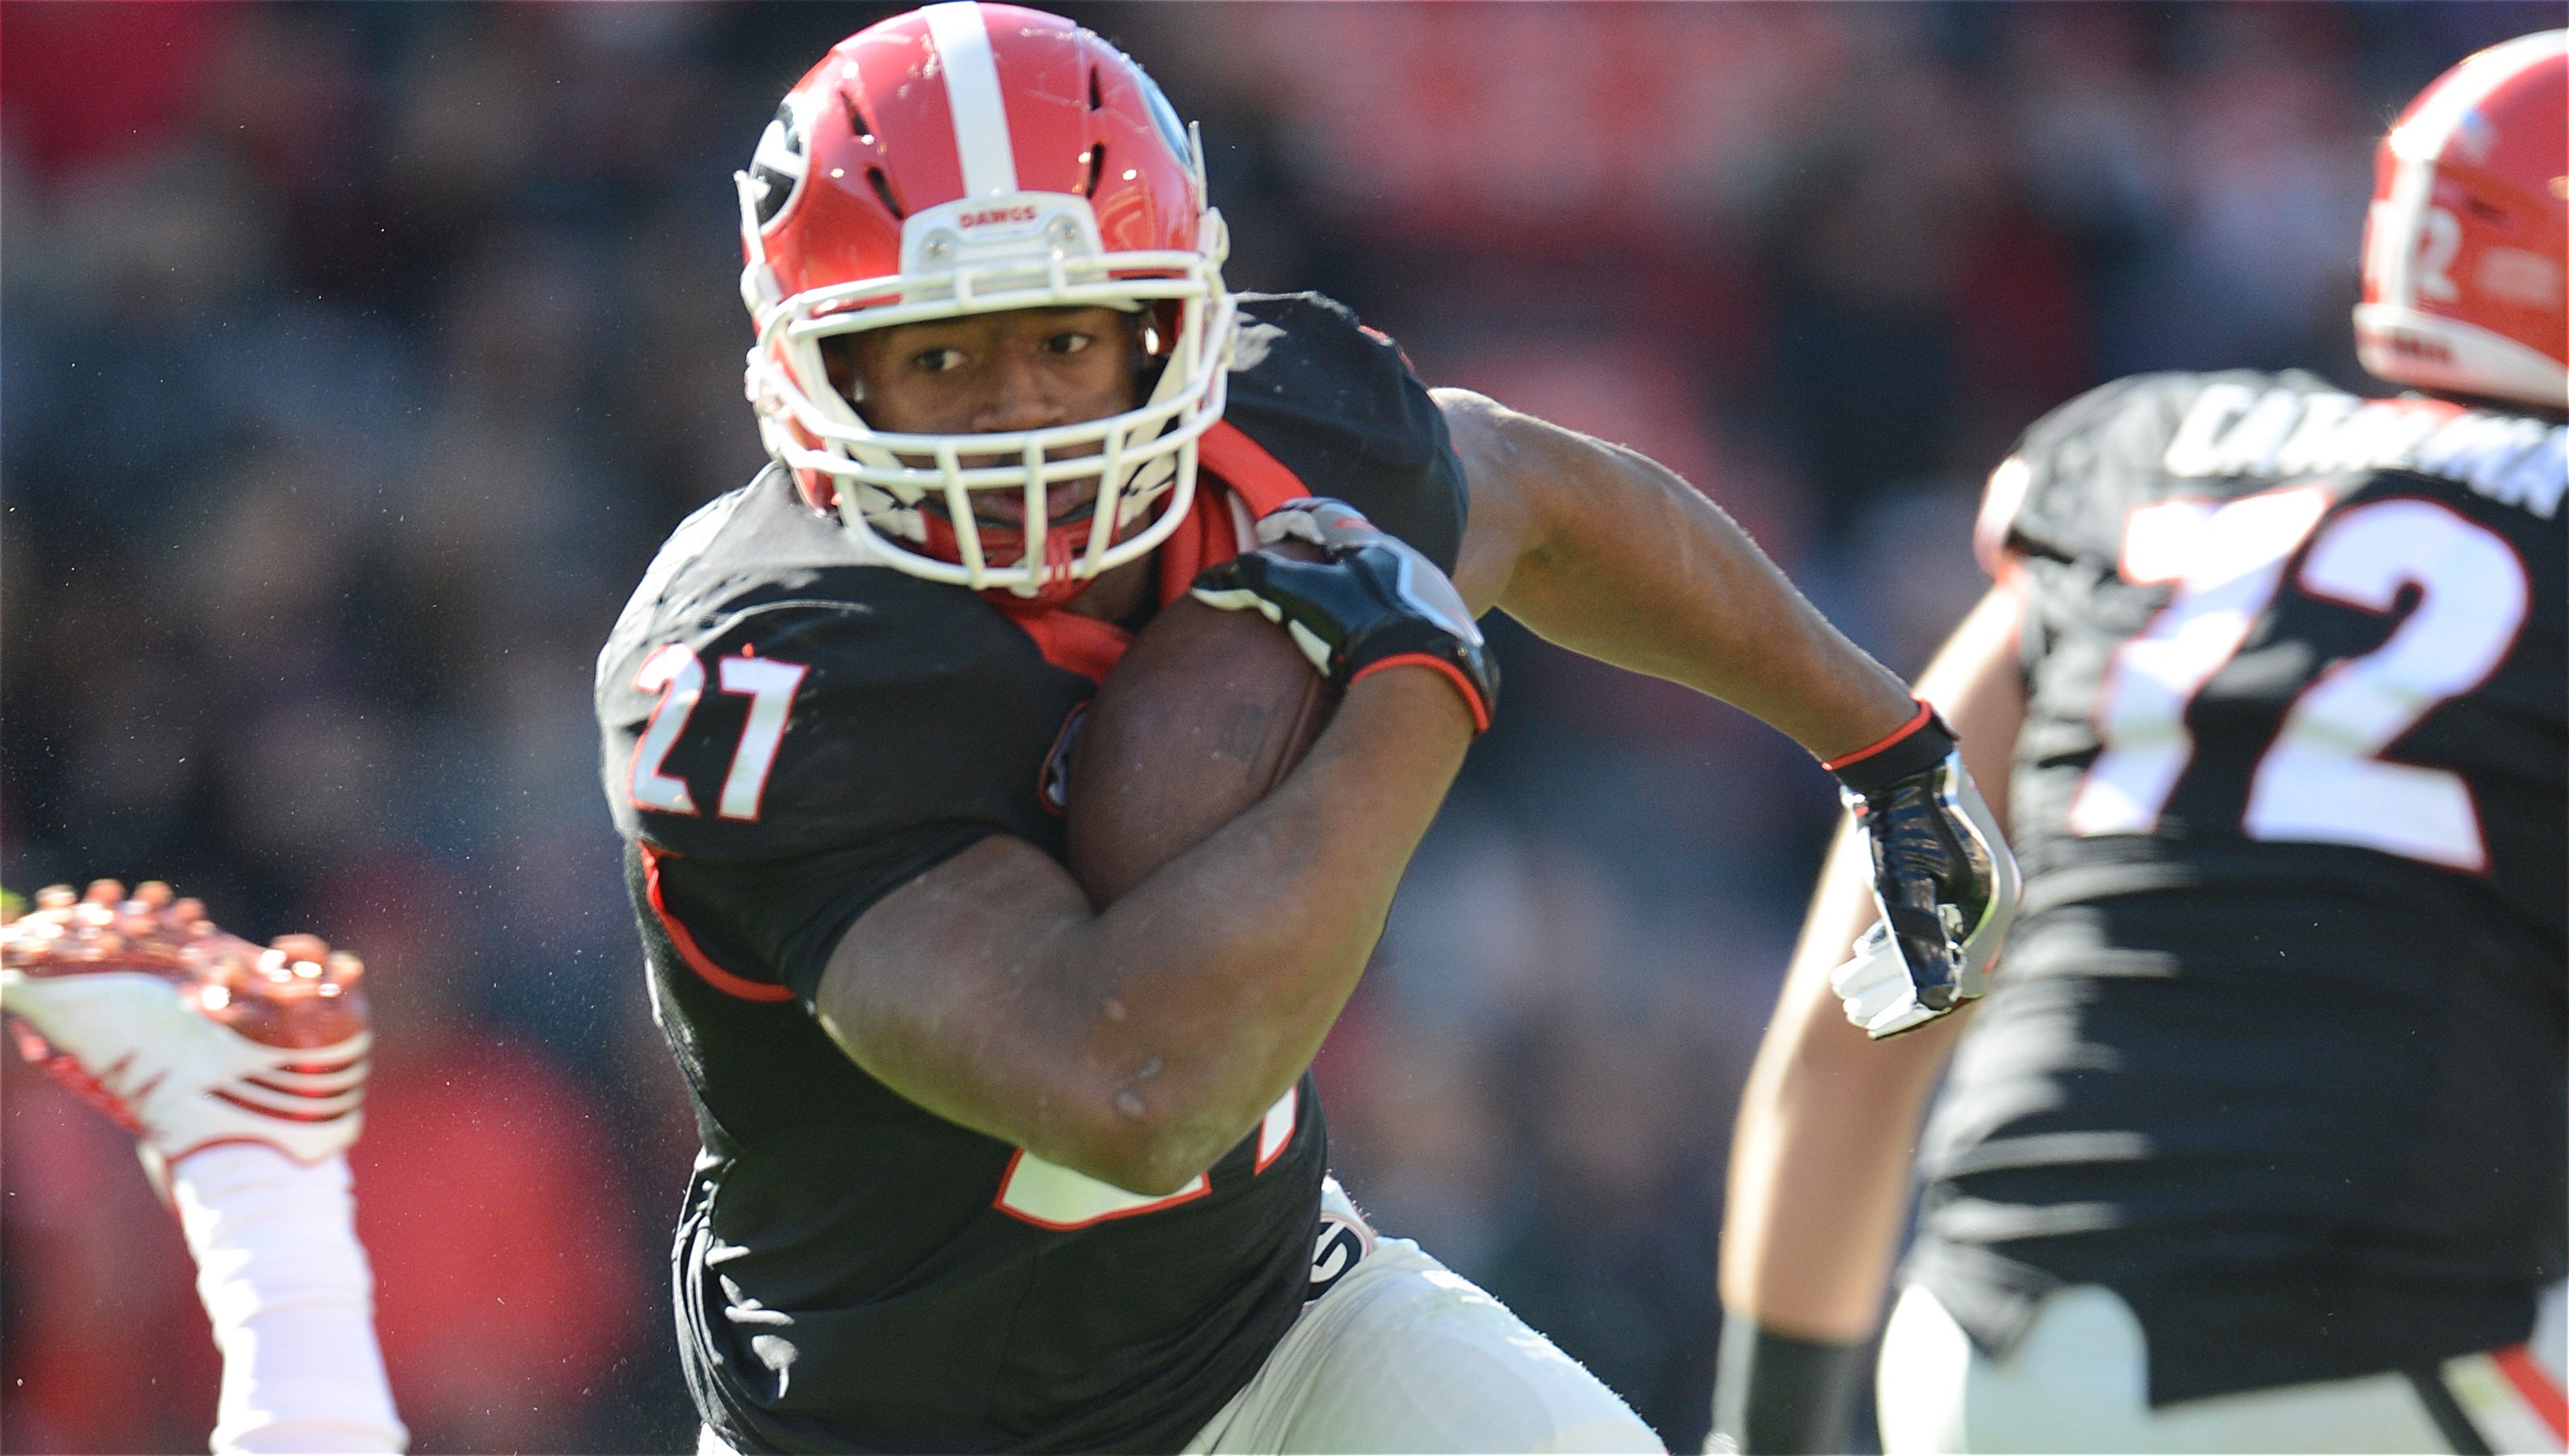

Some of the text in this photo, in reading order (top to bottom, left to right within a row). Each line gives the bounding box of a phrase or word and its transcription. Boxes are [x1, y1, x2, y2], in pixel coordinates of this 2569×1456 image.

[959, 207, 1037, 228] DAWGS
[627, 643, 810, 822] 27
[2067, 485, 2532, 873] 72
